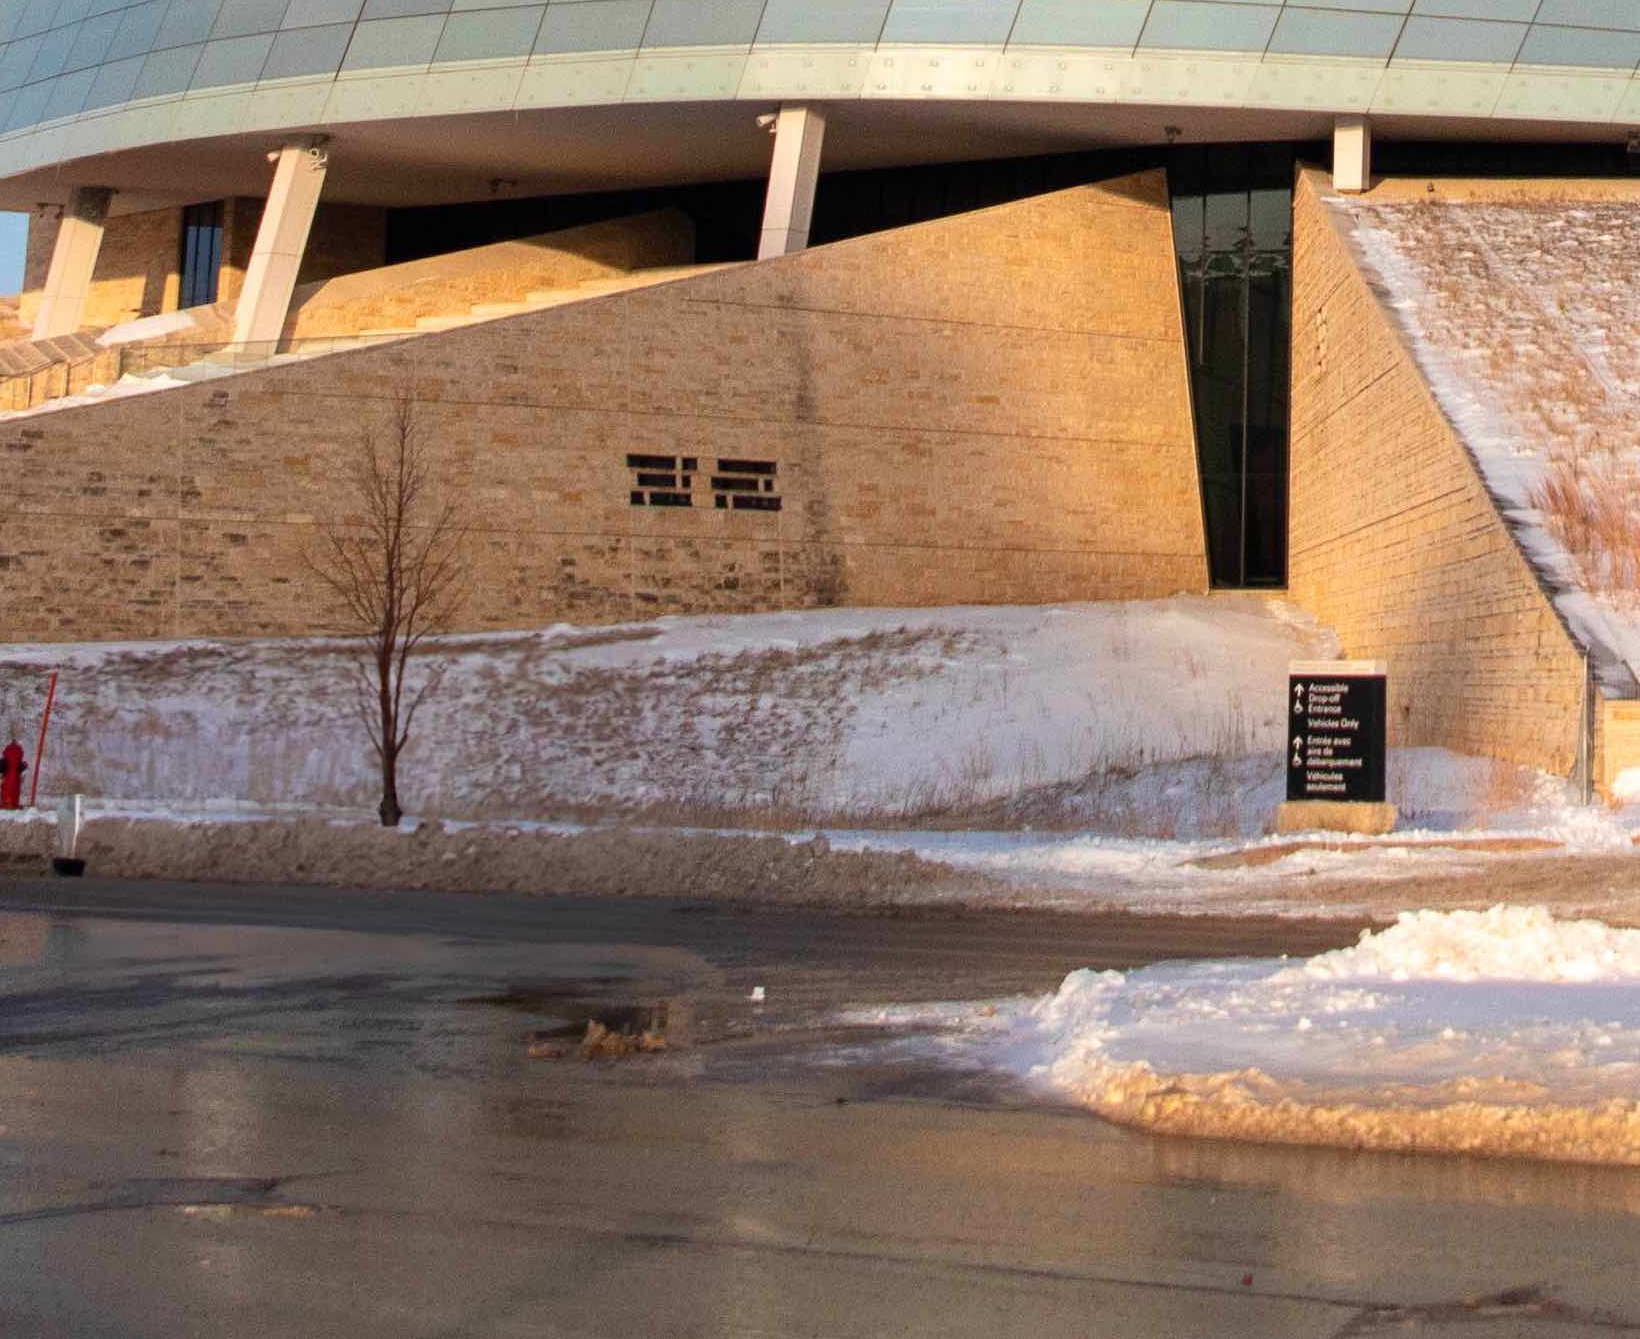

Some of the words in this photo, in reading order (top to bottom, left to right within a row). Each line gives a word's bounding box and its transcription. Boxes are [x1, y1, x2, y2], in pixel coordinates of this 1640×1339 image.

[1309, 683, 1348, 693] Accessible
[1308, 705, 1341, 713] Entrance
[1308, 719, 1339, 728] Vehicles
[1340, 718, 1359, 729] Only
